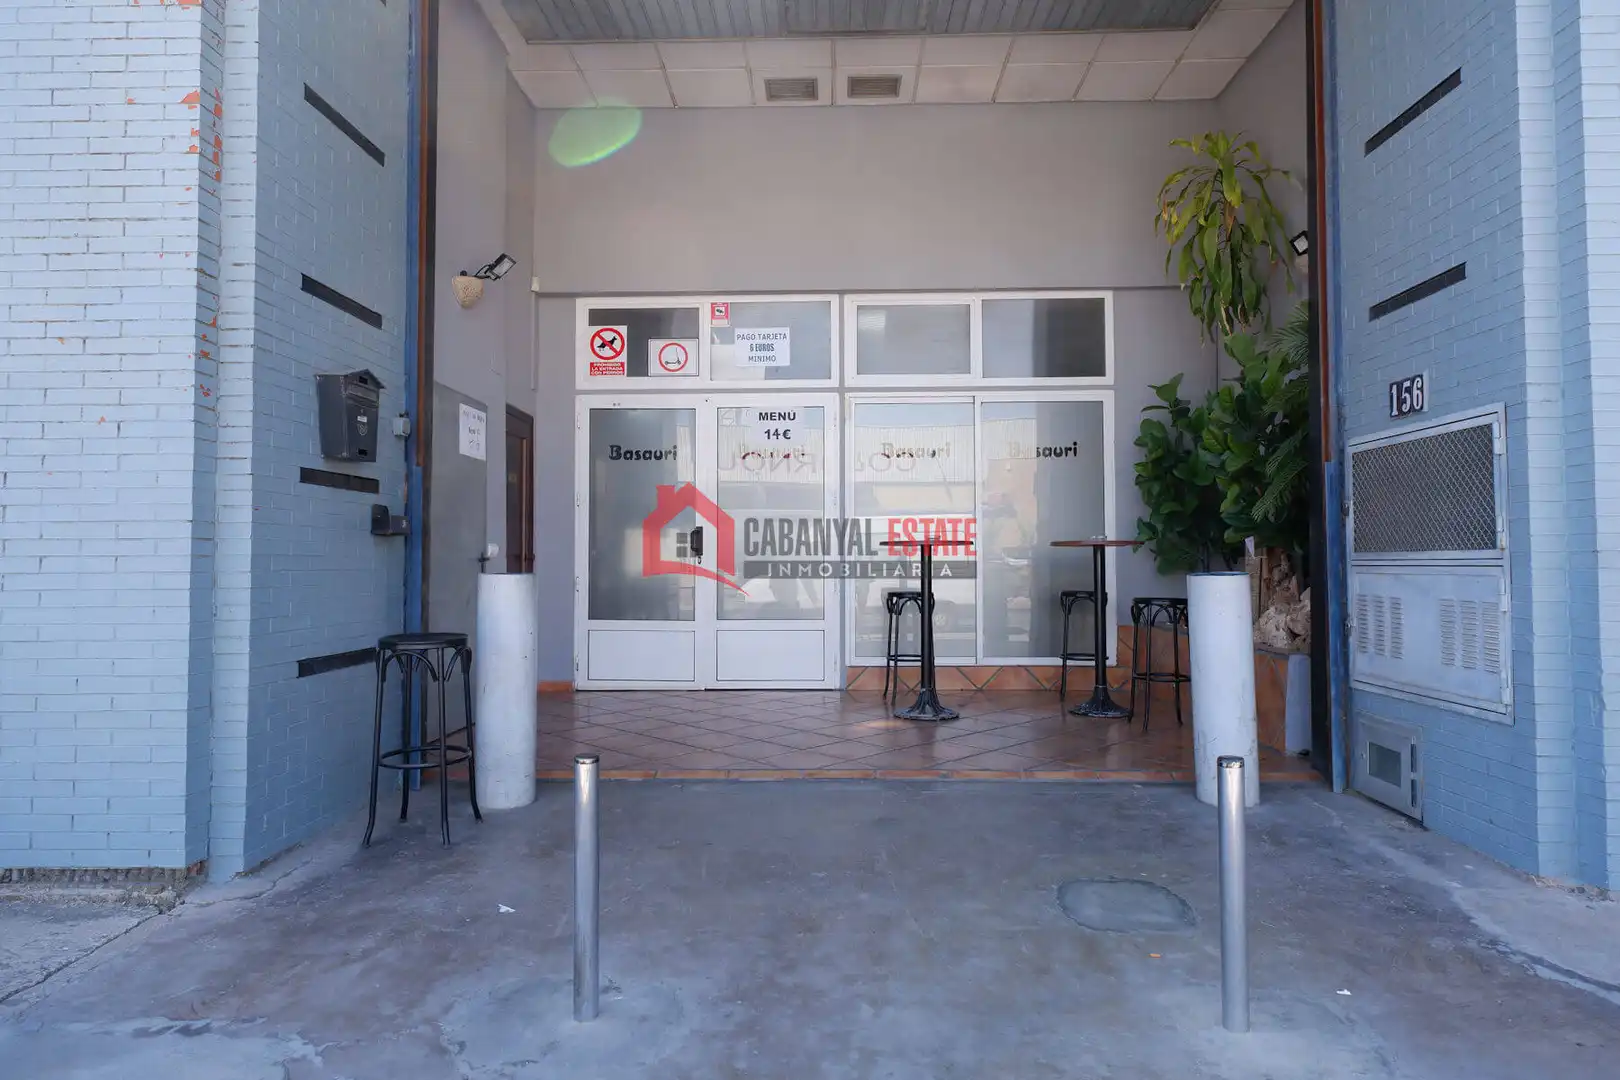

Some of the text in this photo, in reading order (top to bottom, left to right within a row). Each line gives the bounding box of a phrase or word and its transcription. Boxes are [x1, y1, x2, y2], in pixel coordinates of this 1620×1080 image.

[736, 333, 787, 341] PAGO TARJETA
[755, 343, 775, 352] EUROS
[1390, 375, 1424, 417] 156
[758, 409, 796, 421] MENÚ
[764, 429, 791, 440] 14€
[608, 445, 677, 460] Basauri
